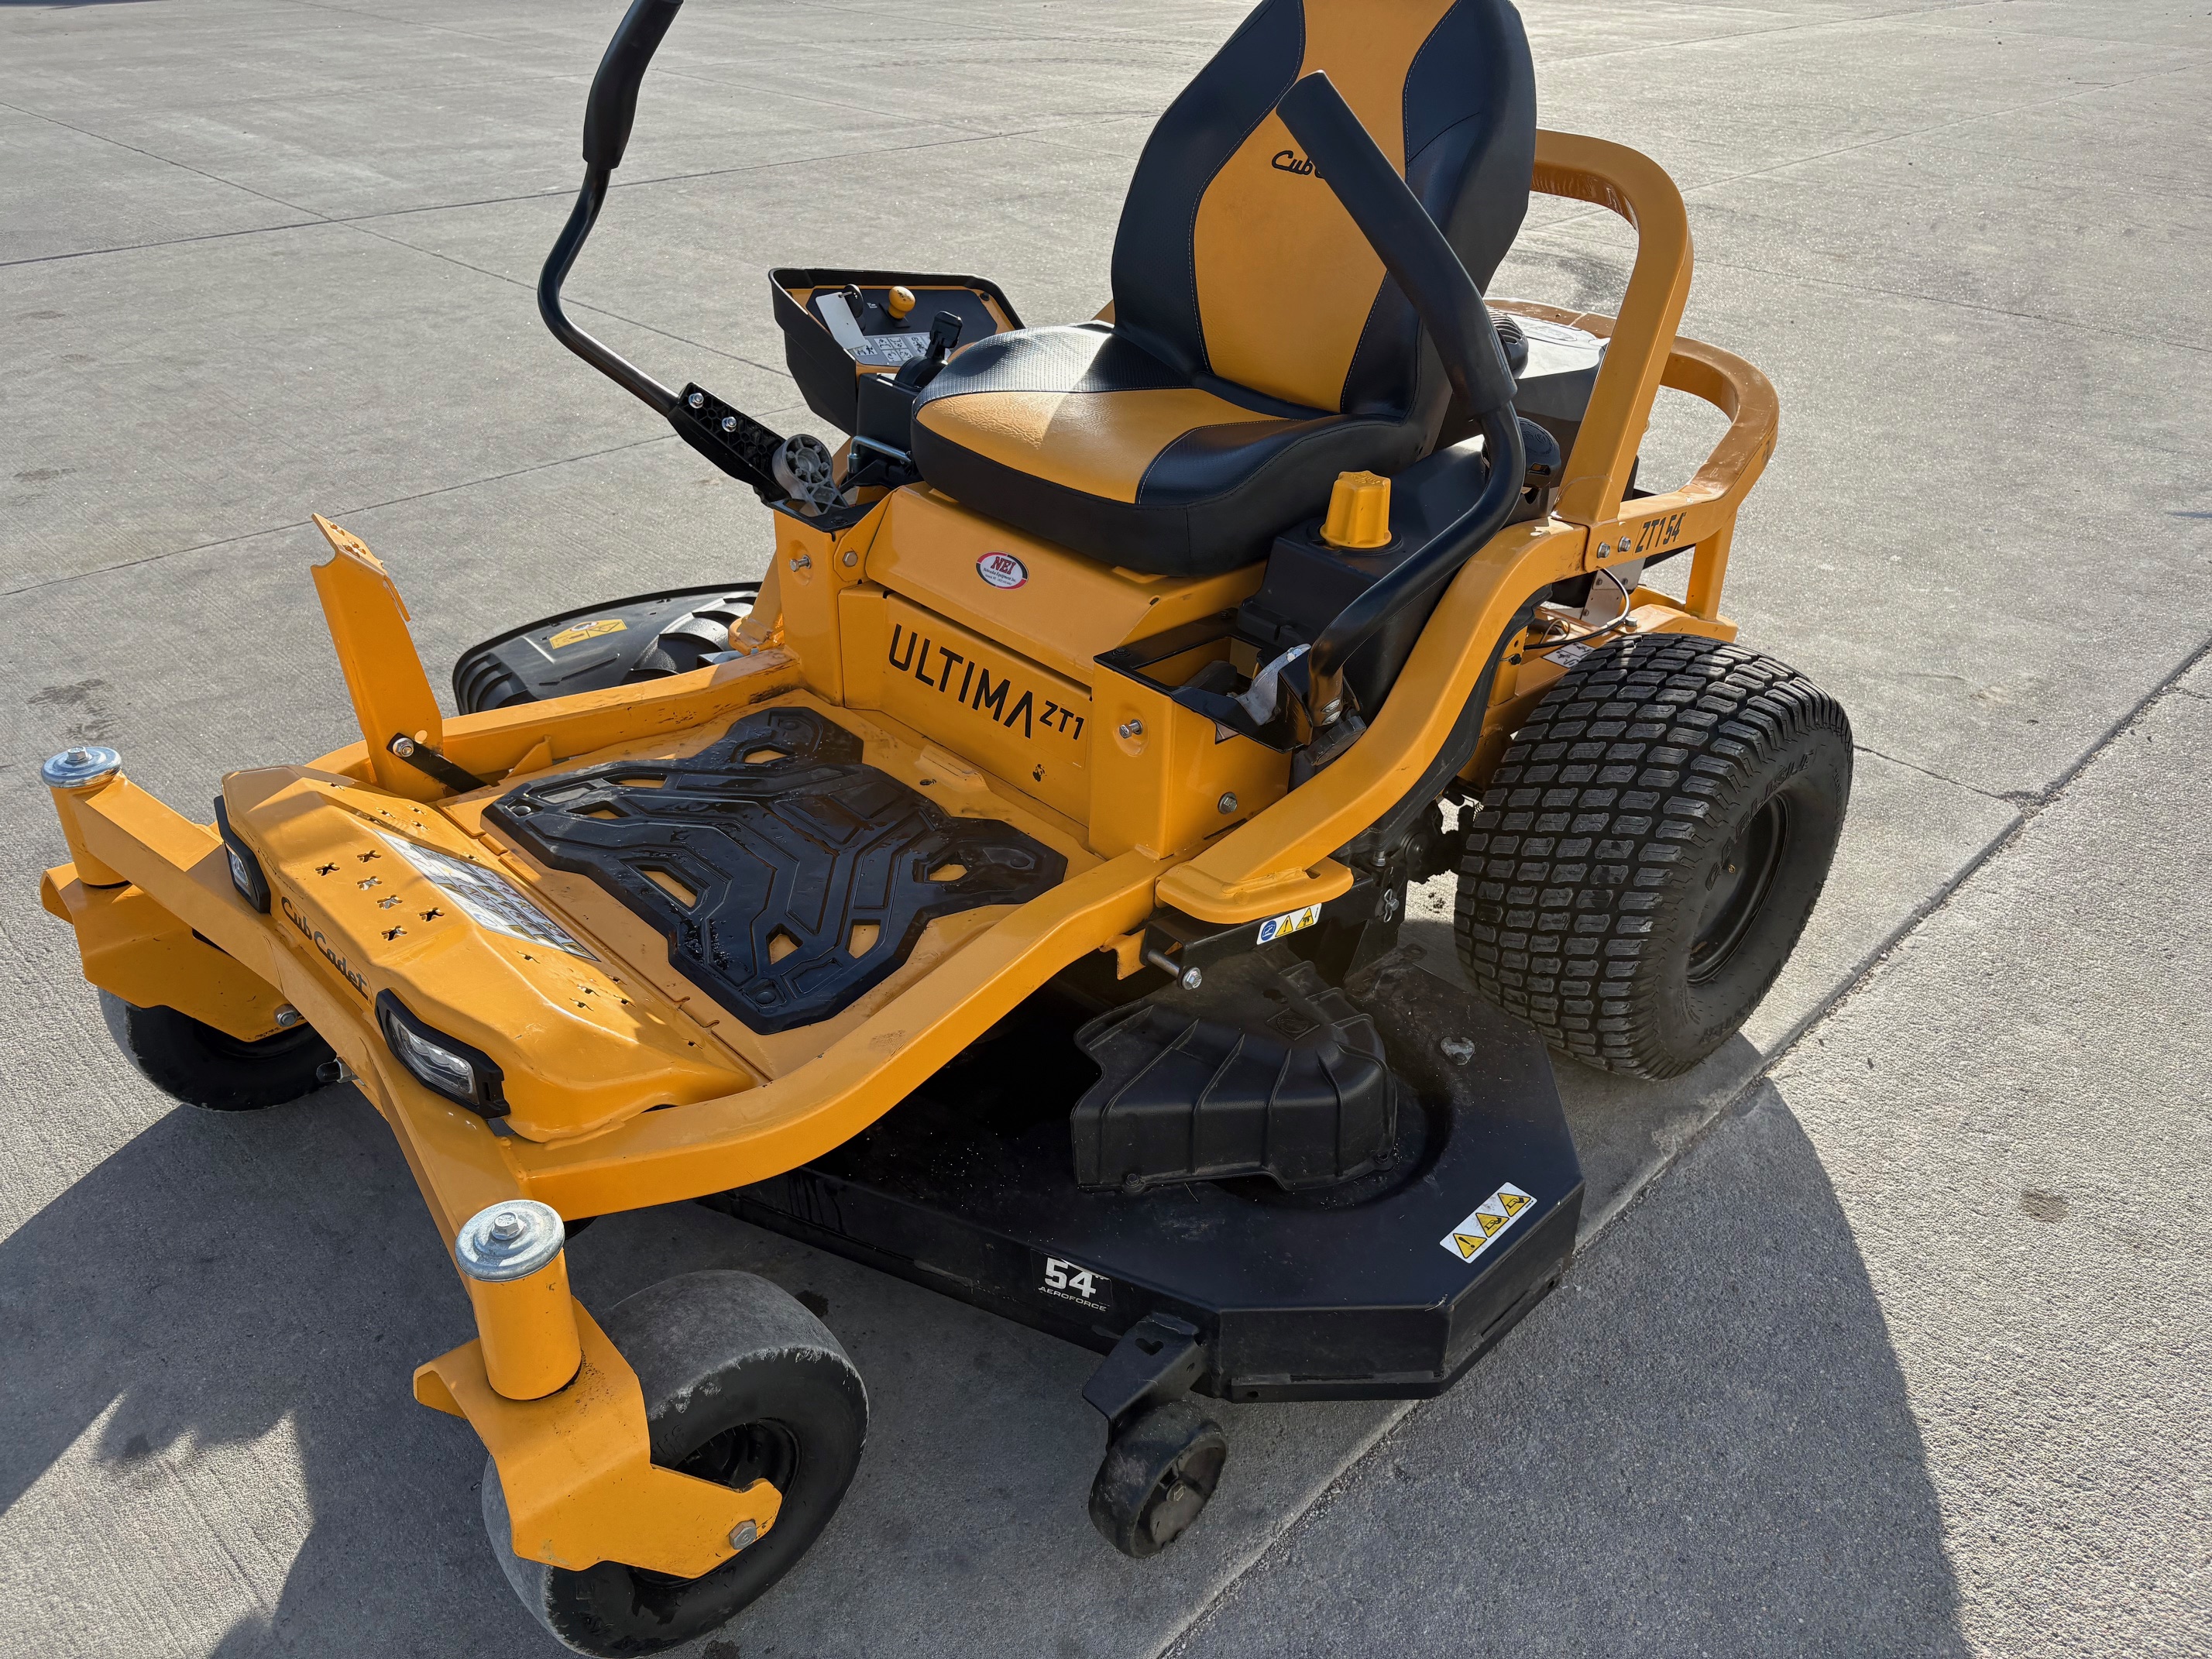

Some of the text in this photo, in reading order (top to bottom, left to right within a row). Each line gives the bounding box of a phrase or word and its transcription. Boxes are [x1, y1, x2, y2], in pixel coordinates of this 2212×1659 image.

[1272, 150, 1313, 175] Cub
[991, 556, 1016, 575] NEI
[889, 623, 1084, 740] ULTIMA ZT1
[281, 896, 368, 1001] Cub Cadet
[1038, 1286, 1108, 1311] AEROFORCE
